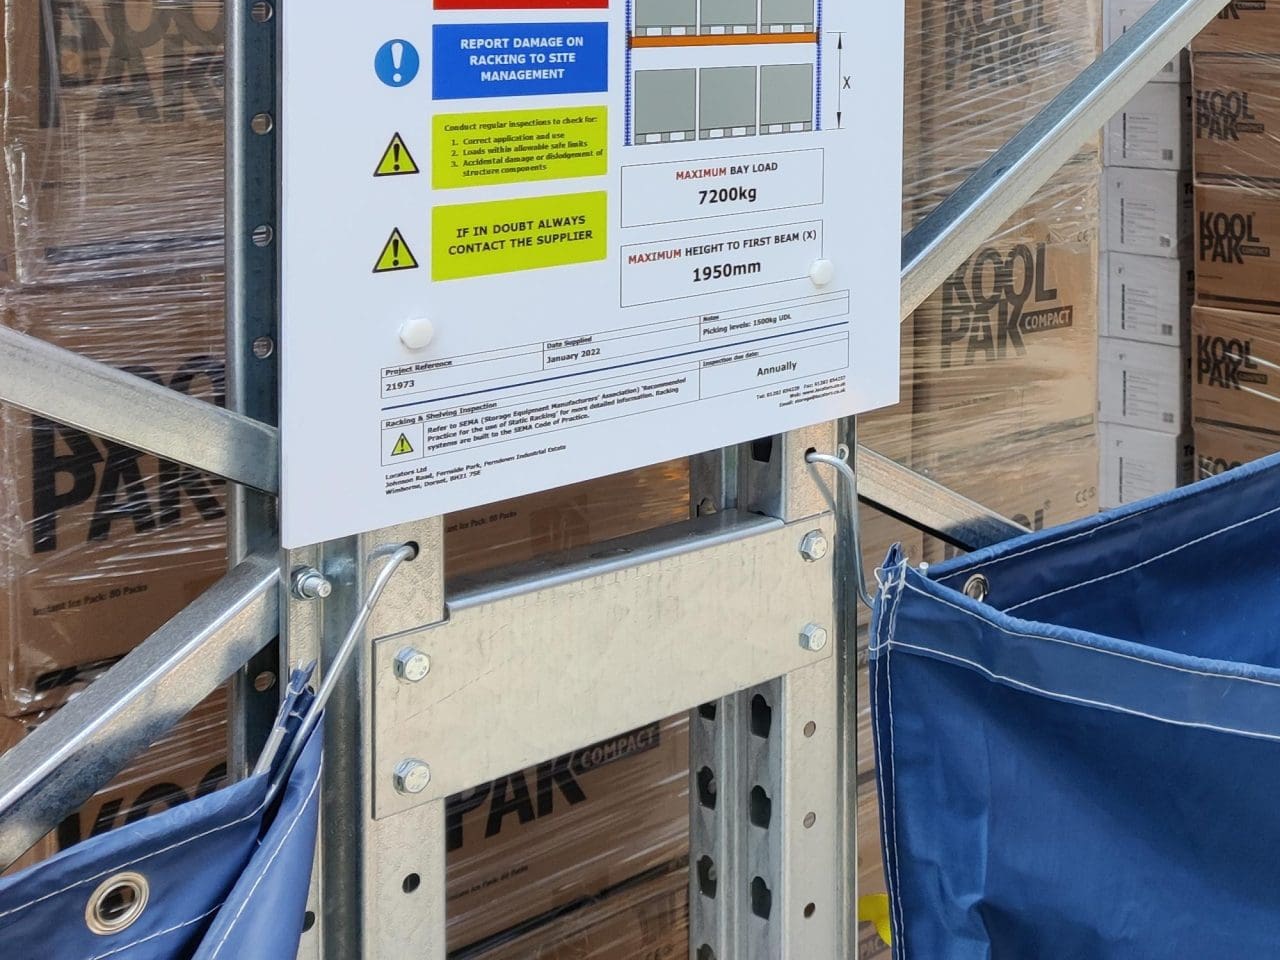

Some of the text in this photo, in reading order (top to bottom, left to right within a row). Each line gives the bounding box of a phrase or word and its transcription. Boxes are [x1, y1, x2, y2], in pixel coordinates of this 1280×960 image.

[461, 37, 583, 50] REPORT DAMAGE ON
[470, 53, 576, 65] RACKING TO SITE
[944, 31, 1029, 91] PAK
[481, 69, 565, 81] MANAGEMENT
[843, 76, 851, 89] X
[445, 123, 476, 131] Conduct
[479, 121, 507, 130] regular
[509, 119, 551, 128] inspections
[562, 116, 583, 124] check
[463, 137, 491, 145] Correct
[493, 134, 534, 143] application
[514, 143, 549, 151] allowable
[463, 157, 503, 166] Accidental
[505, 155, 534, 163] damage
[546, 151, 593, 160] dislodgement
[596, 148, 603, 156] of
[463, 164, 547, 177] structure components
[676, 162, 778, 180] MAXIMUM BAY LOAD
[699, 186, 757, 205] 7200kg
[457, 215, 586, 238] IF IN DOUBT ALWAYS
[1200, 211, 1260, 242] KOOL
[448, 230, 593, 255] CONTACT THE SUPPLIER
[628, 230, 817, 264] MAXIMUM HEIGHT TO FIRST BEAM (X)
[1200, 236, 1244, 265] PAK
[693, 261, 761, 282] 1950mm
[942, 242, 1058, 308] KOOL
[703, 324, 727, 336] Picking
[729, 320, 751, 331] levels:
[753, 316, 777, 327] 1500kg
[940, 299, 1071, 370] PAK COMPACT
[564, 336, 592, 346] Supplied
[547, 348, 600, 363] January 2022
[386, 361, 452, 375] Project Reference
[757, 361, 797, 376] Annually
[386, 380, 415, 391] 21973
[386, 417, 415, 427] Racking
[426, 410, 457, 419] Shelving
[460, 402, 497, 413] Inspection
[445, 726, 656, 852] PAK COMPACT
